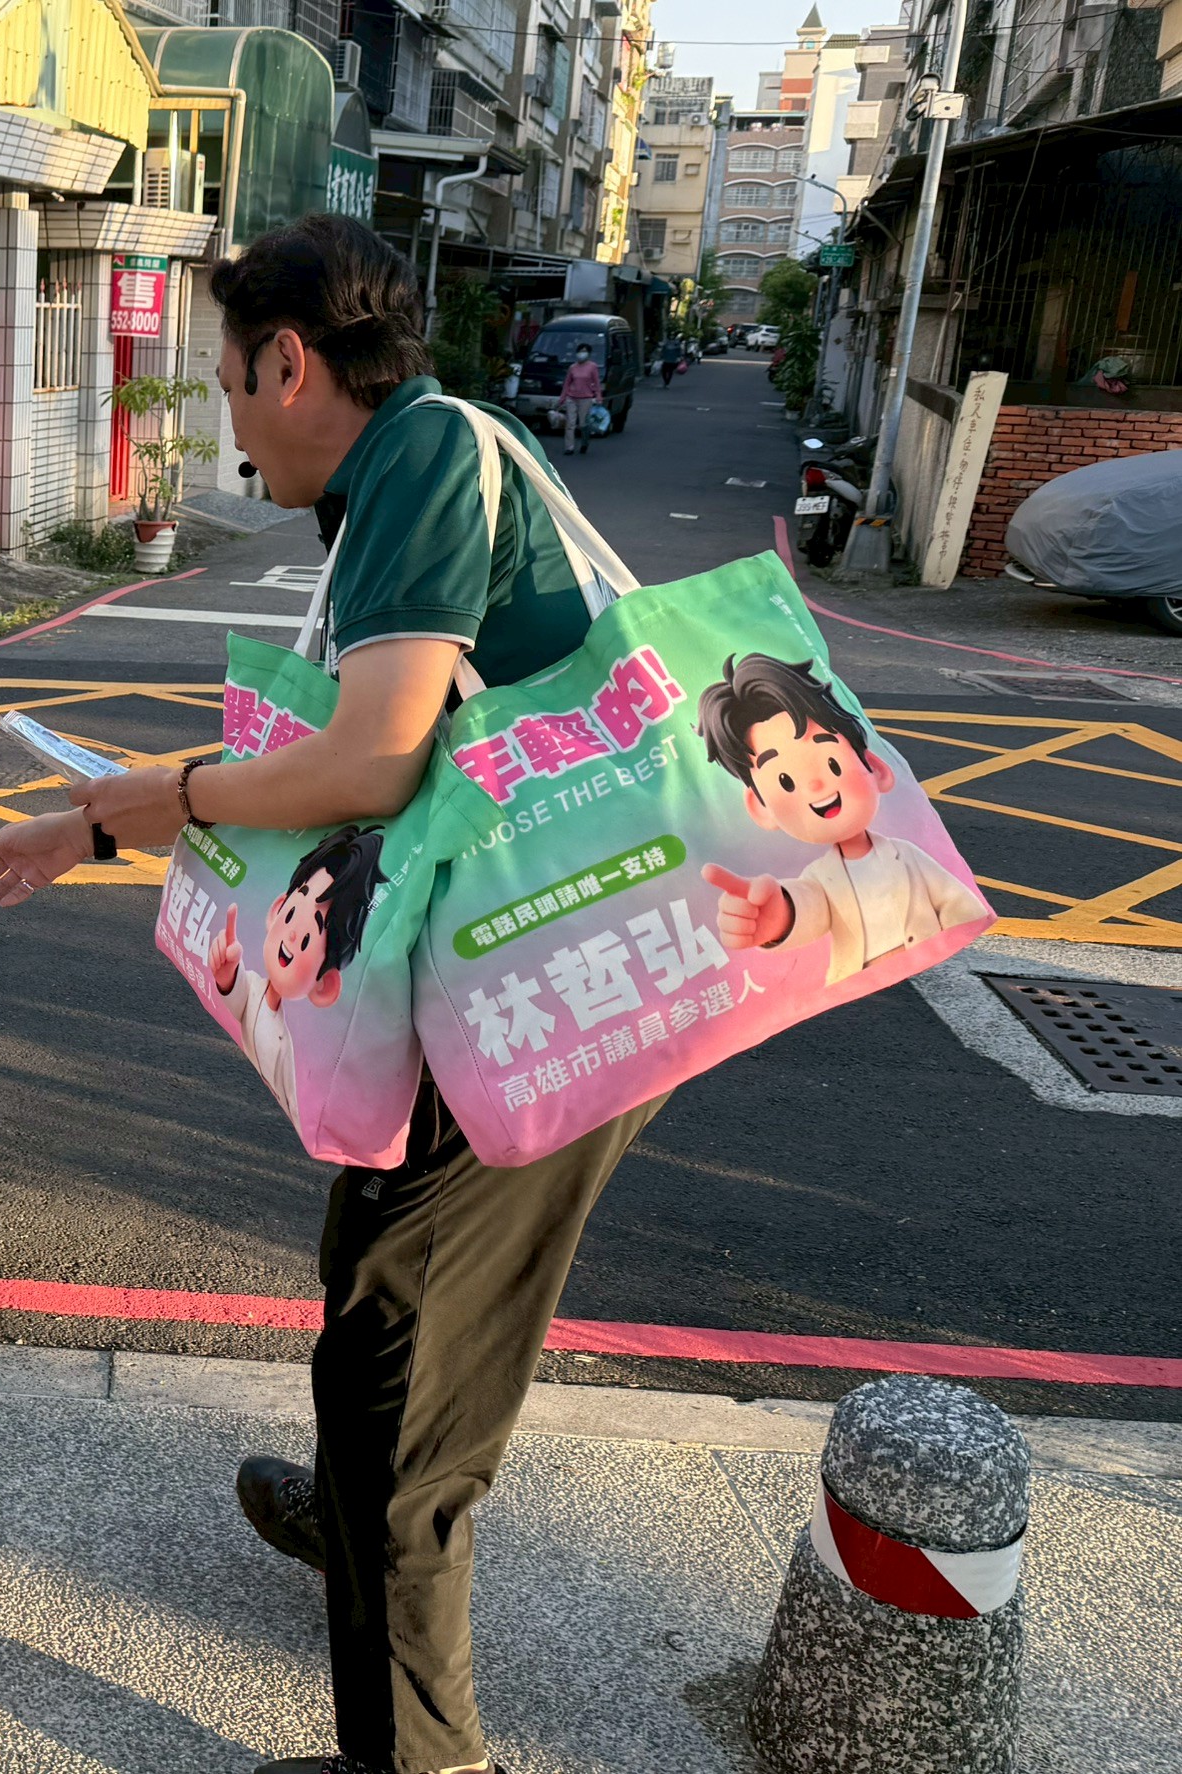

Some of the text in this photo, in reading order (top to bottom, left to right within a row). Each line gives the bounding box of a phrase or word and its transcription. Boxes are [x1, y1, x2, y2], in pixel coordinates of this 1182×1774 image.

[111, 310, 159, 332] 552-8000
[117, 272, 157, 309] 售
[554, 772, 612, 812] THE
[615, 734, 679, 787] BEST
[161, 862, 217, 968] 哲弘
[470, 846, 667, 947] 電話民調請唯一支持
[464, 898, 730, 1068] 林哲弘
